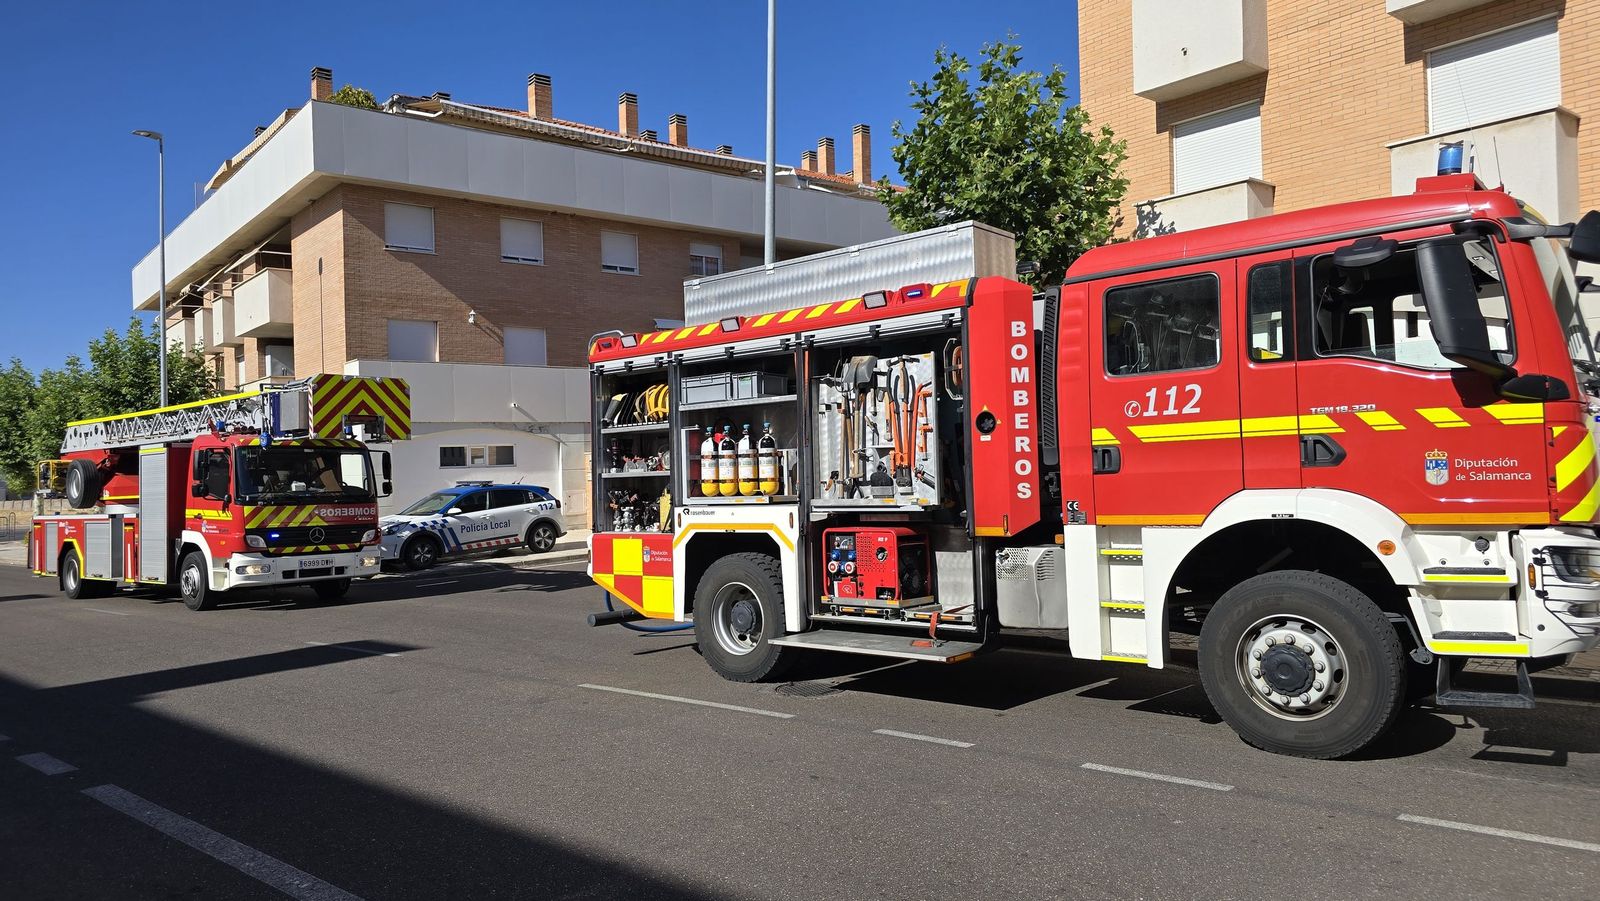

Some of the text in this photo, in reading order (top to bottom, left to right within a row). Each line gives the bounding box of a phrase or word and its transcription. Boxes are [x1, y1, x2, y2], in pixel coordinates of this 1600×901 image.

[1143, 383, 1202, 417] 112
[1010, 321, 1032, 499] BOMBEROS
[1310, 404, 1376, 414] TGM 18.320
[1454, 457, 1518, 469] Diputación
[1455, 471, 1532, 481] de Salamanca
[538, 502, 554, 511] 112
[460, 519, 511, 533] Policía Local
